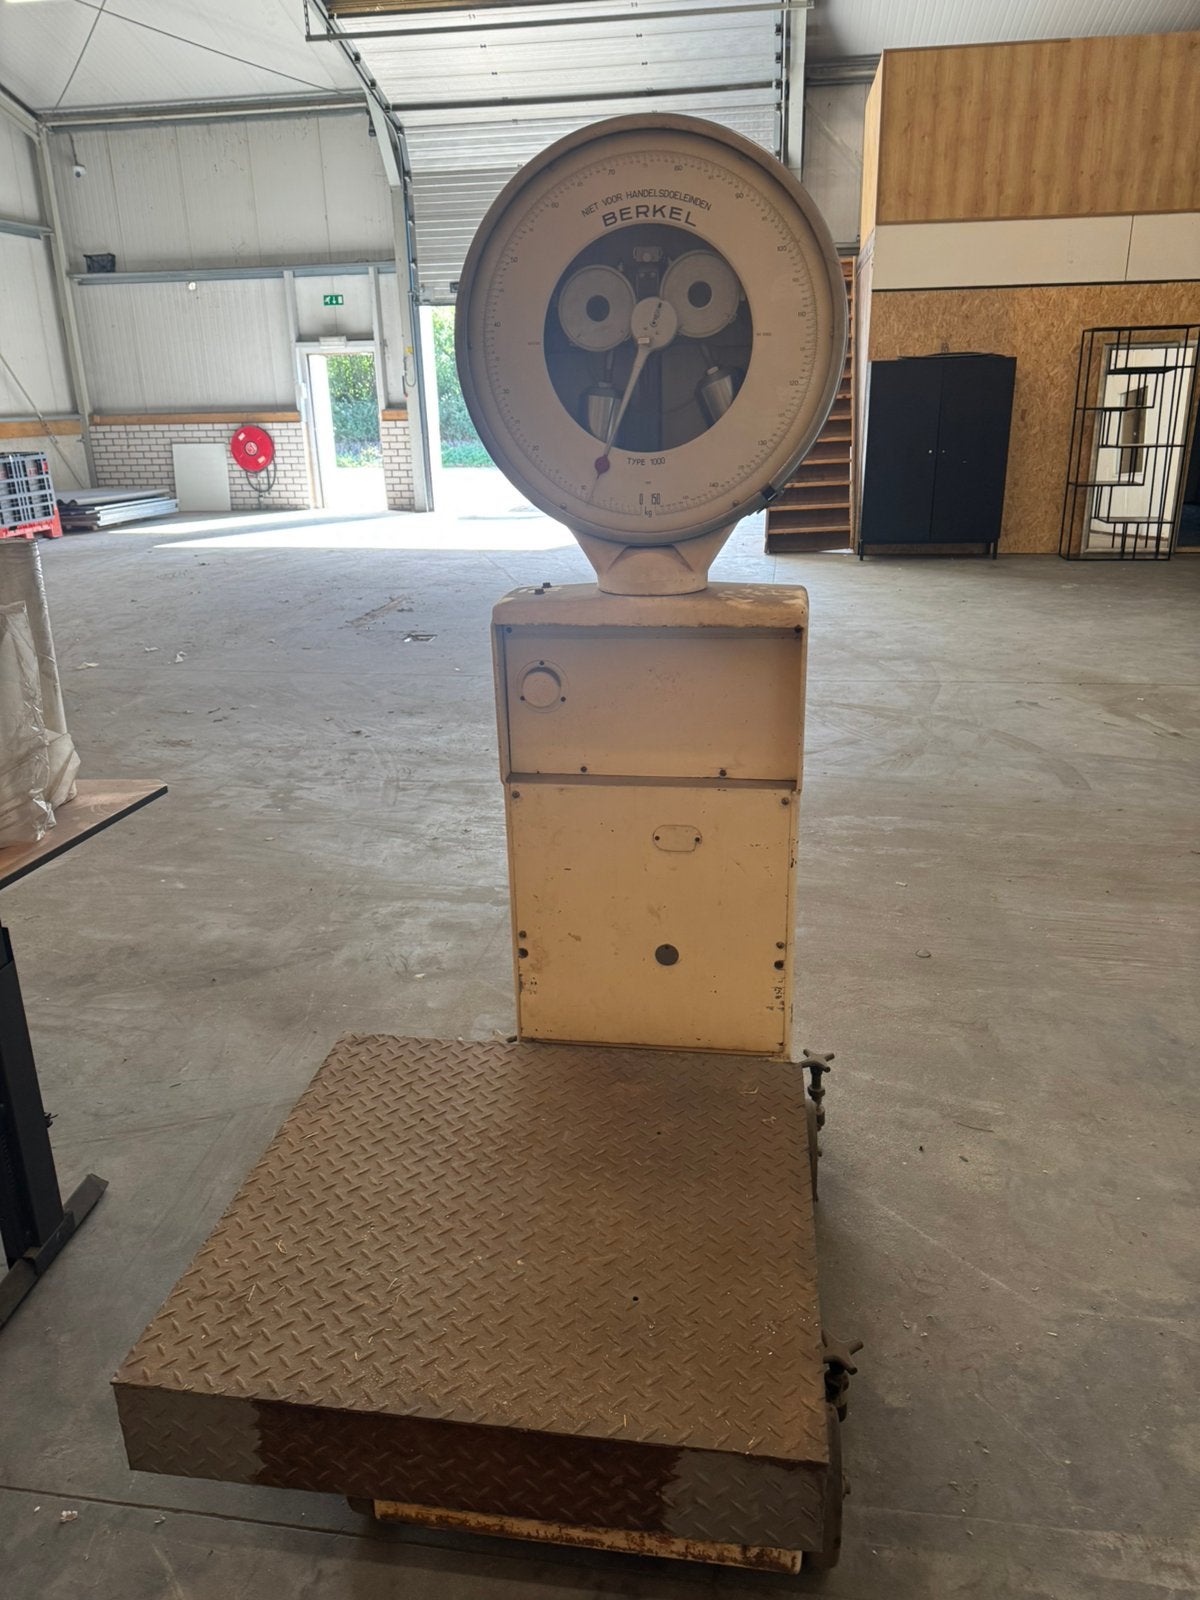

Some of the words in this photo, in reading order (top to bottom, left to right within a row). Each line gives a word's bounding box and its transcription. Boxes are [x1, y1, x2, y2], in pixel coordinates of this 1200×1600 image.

[581, 201, 600, 218] NIET
[601, 192, 623, 207] VOOR
[625, 188, 712, 211] HANDELSDOELEINDEN
[601, 204, 697, 227] BERKEL
[627, 457, 646, 466] TYPE
[650, 456, 666, 466] 1000
[638, 492, 644, 506] 0
[644, 505, 653, 518] kg
